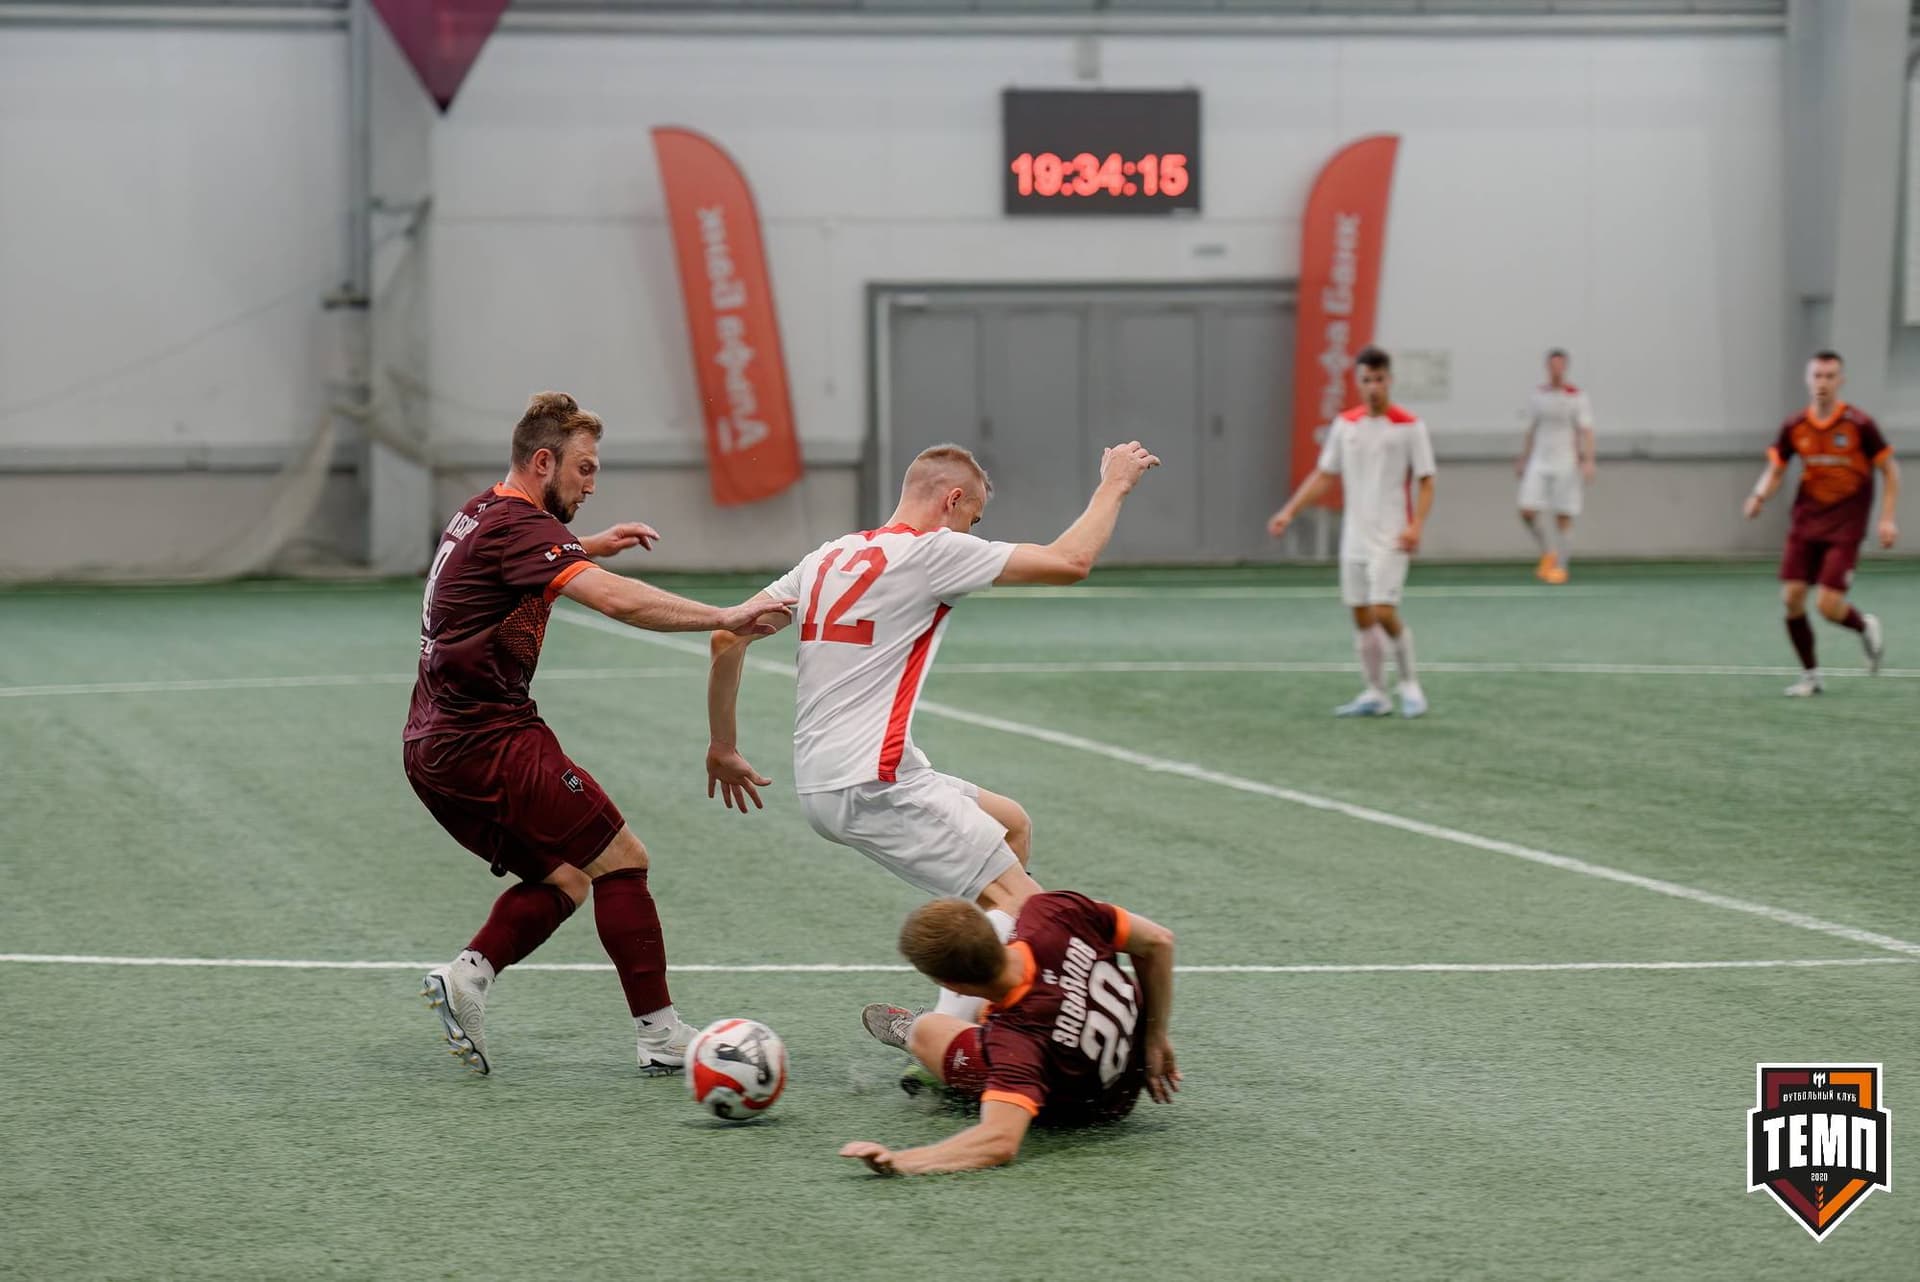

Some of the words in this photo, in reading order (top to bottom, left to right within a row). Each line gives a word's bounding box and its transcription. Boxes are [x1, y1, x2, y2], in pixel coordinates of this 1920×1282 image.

[1011, 152, 1189, 197] 19:34:15
[800, 546, 888, 646] 12
[1080, 960, 1139, 1089] 20
